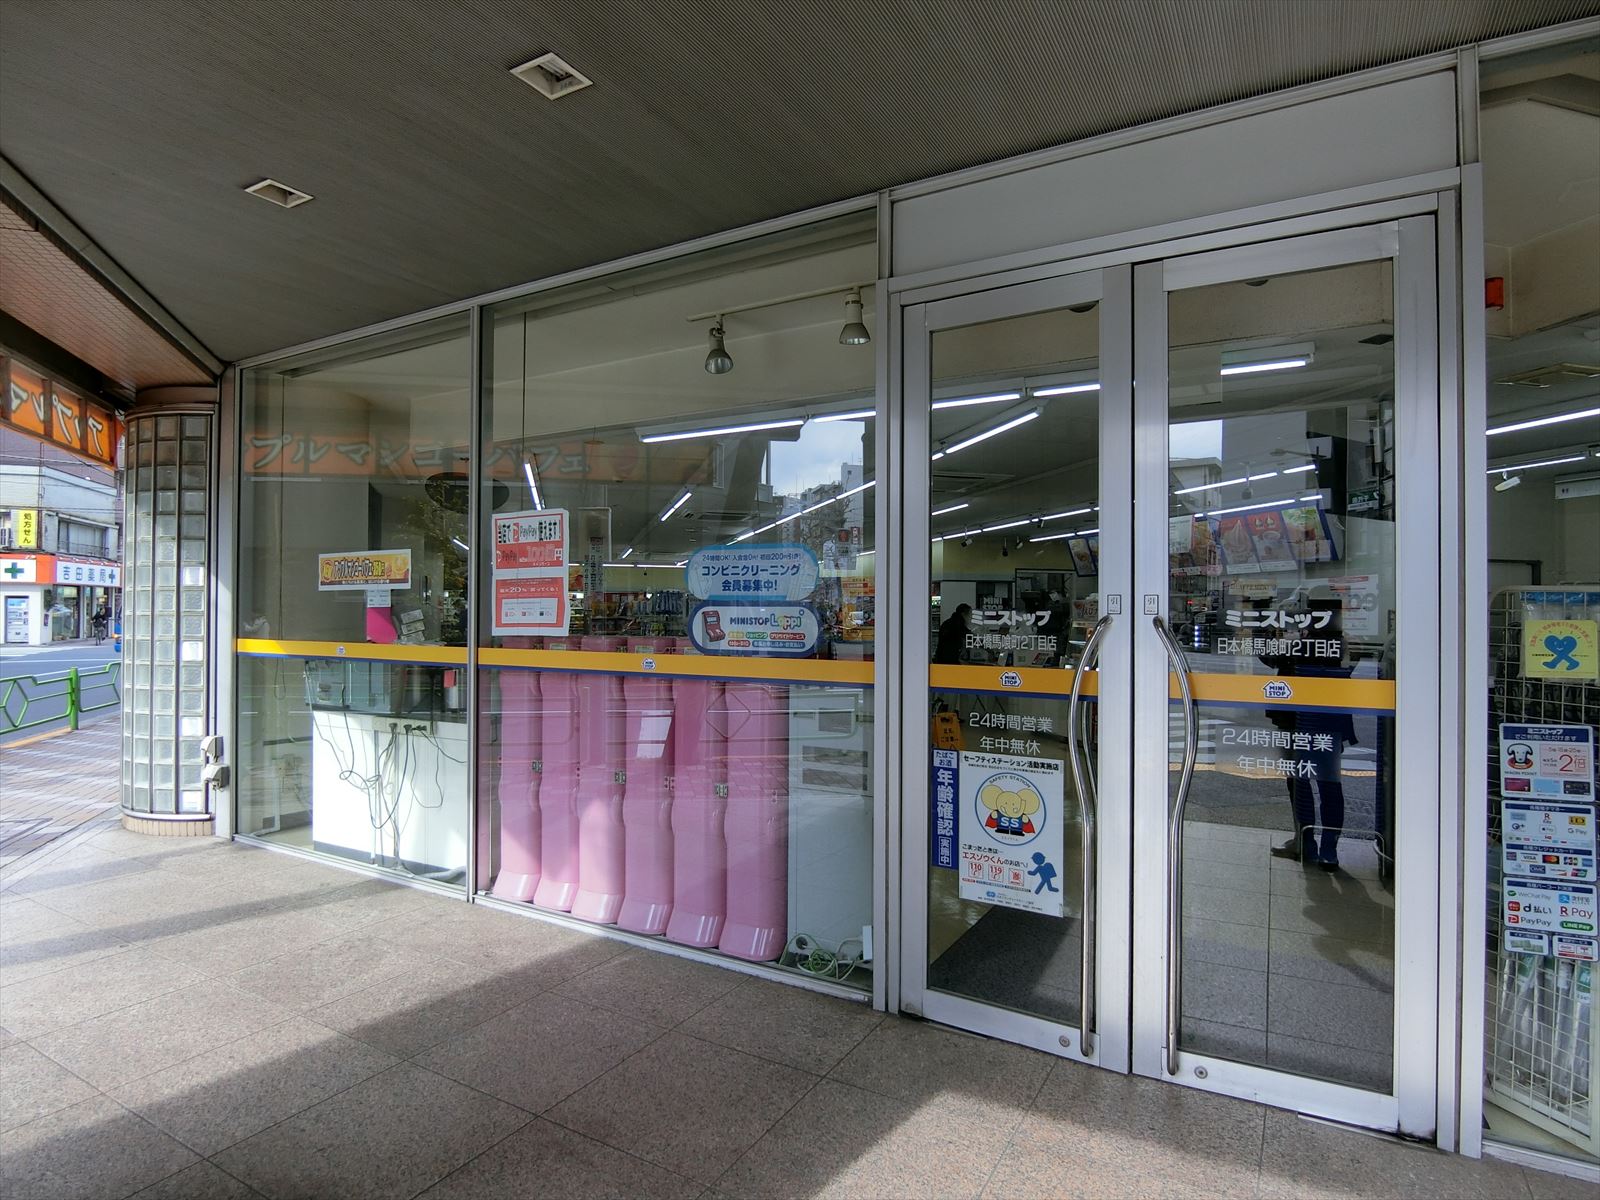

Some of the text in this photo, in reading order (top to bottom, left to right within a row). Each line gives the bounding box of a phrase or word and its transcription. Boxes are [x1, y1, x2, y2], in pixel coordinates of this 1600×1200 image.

[23, 512, 32, 544] 処方せん
[701, 564, 801, 577] コンビニクリーニング
[721, 579, 778, 592] 会員募集中!
[730, 616, 770, 626] MINISTOP
[971, 609, 1052, 626] ミニストップ
[1225, 609, 1333, 629] ミニストップ
[965, 634, 1058, 651] 日本橋馬喰町2丁目店
[1217, 637, 1341, 658] 日本橋馬喰町2丁目店
[969, 712, 1053, 733] 24時間営業
[980, 736, 1041, 755] 年中無休
[1222, 728, 1334, 752] 24時間営業
[1236, 756, 1318, 778] 年中無休
[937, 769, 954, 836] 年齢確認
[1000, 817, 1020, 828] SS
[990, 866, 1003, 874] 119
[1520, 916, 1552, 927] PayPay
[1571, 907, 1594, 919] Pay
